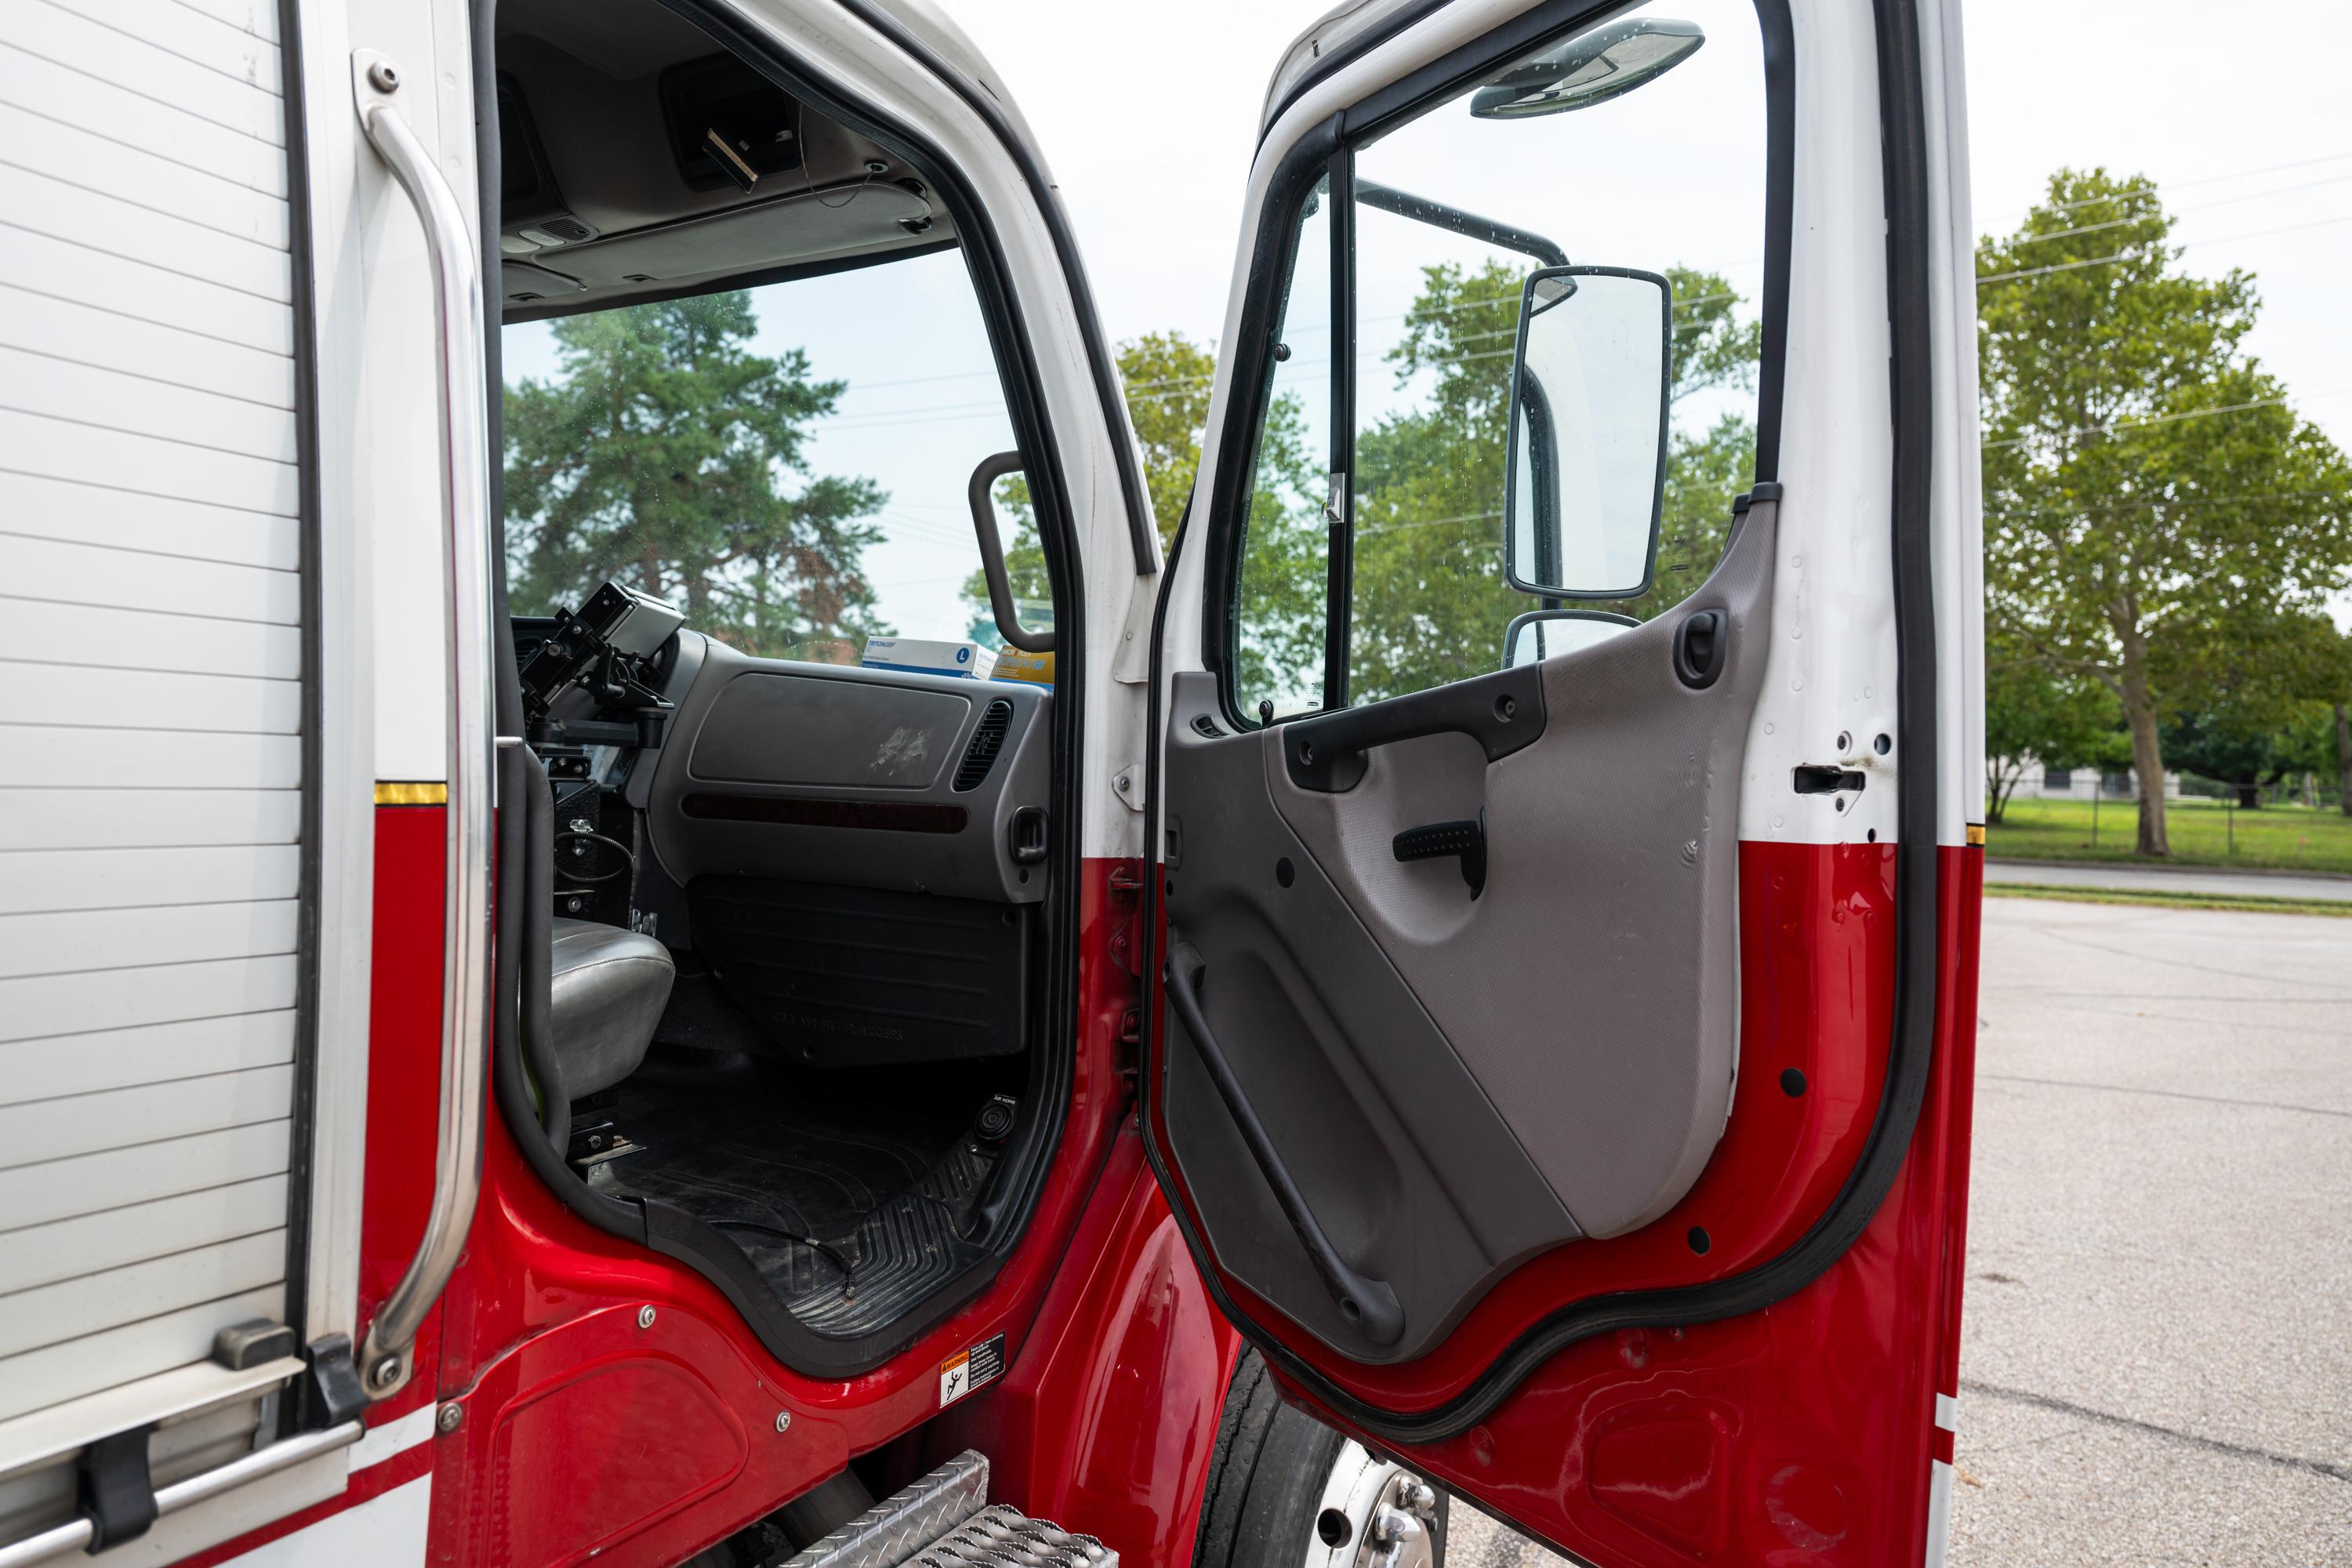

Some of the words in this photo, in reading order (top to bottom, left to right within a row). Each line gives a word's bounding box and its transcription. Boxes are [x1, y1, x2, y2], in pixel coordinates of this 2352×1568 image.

[960, 651, 965, 660] L
[820, 1018, 855, 1036] FILTER
[858, 1025, 904, 1042] ACCESS
[946, 1353, 968, 1370] WARNING
